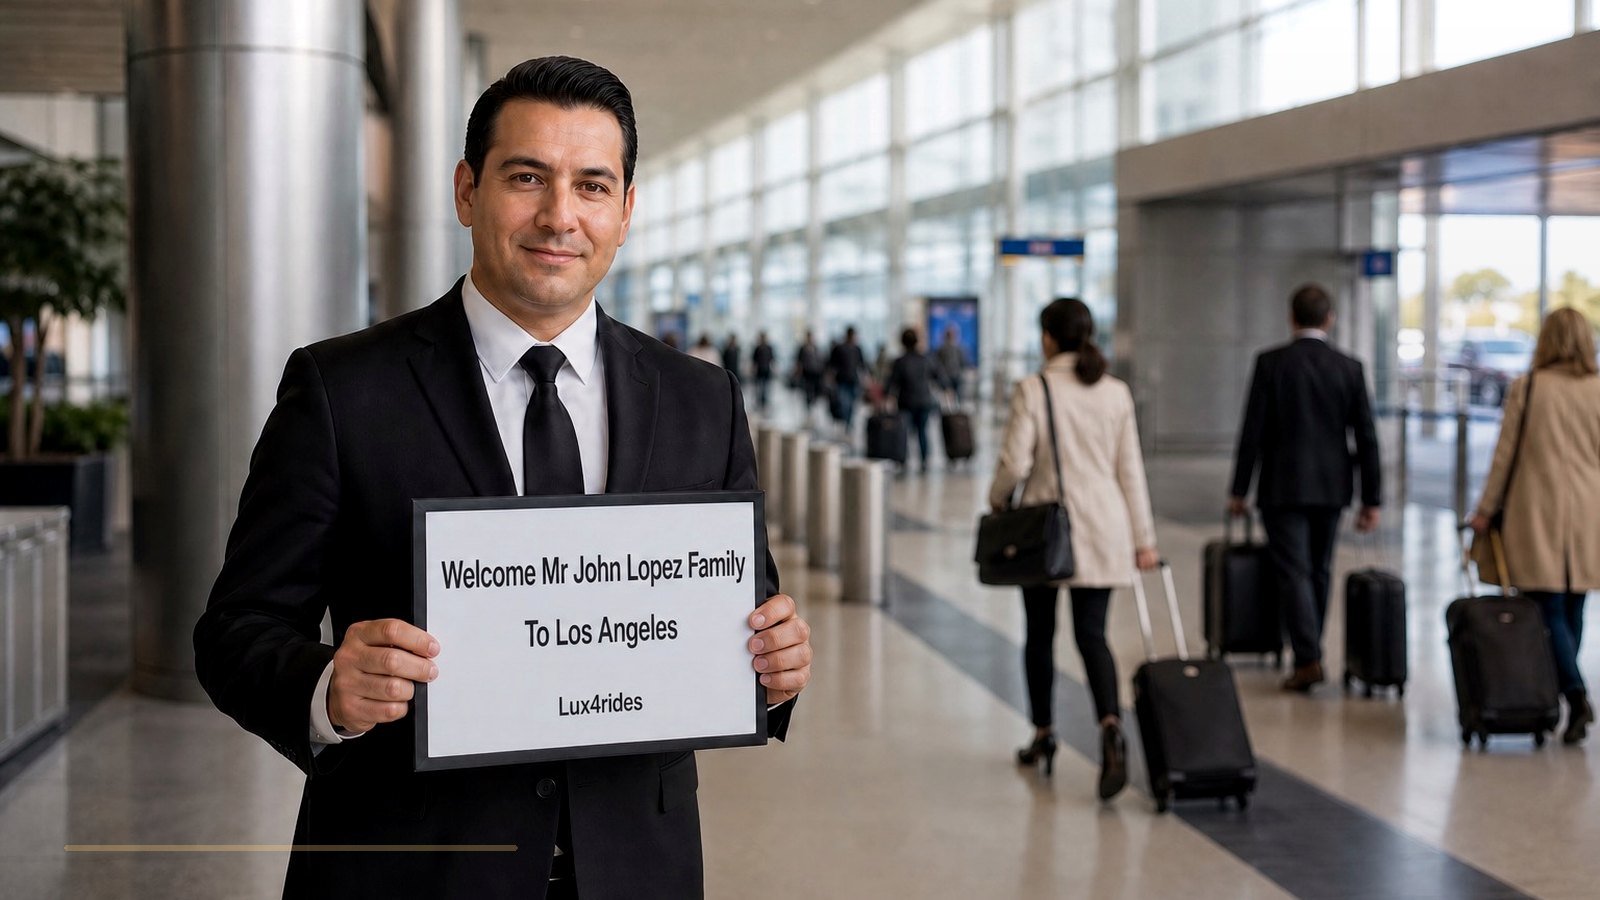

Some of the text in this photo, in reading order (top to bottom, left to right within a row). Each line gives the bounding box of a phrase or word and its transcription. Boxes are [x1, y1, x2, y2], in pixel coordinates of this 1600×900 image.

[441, 549, 746, 590] Welcome Mr John Lopez Family
[524, 613, 678, 649] To Los Angeles
[558, 691, 643, 717] Lux4rides
